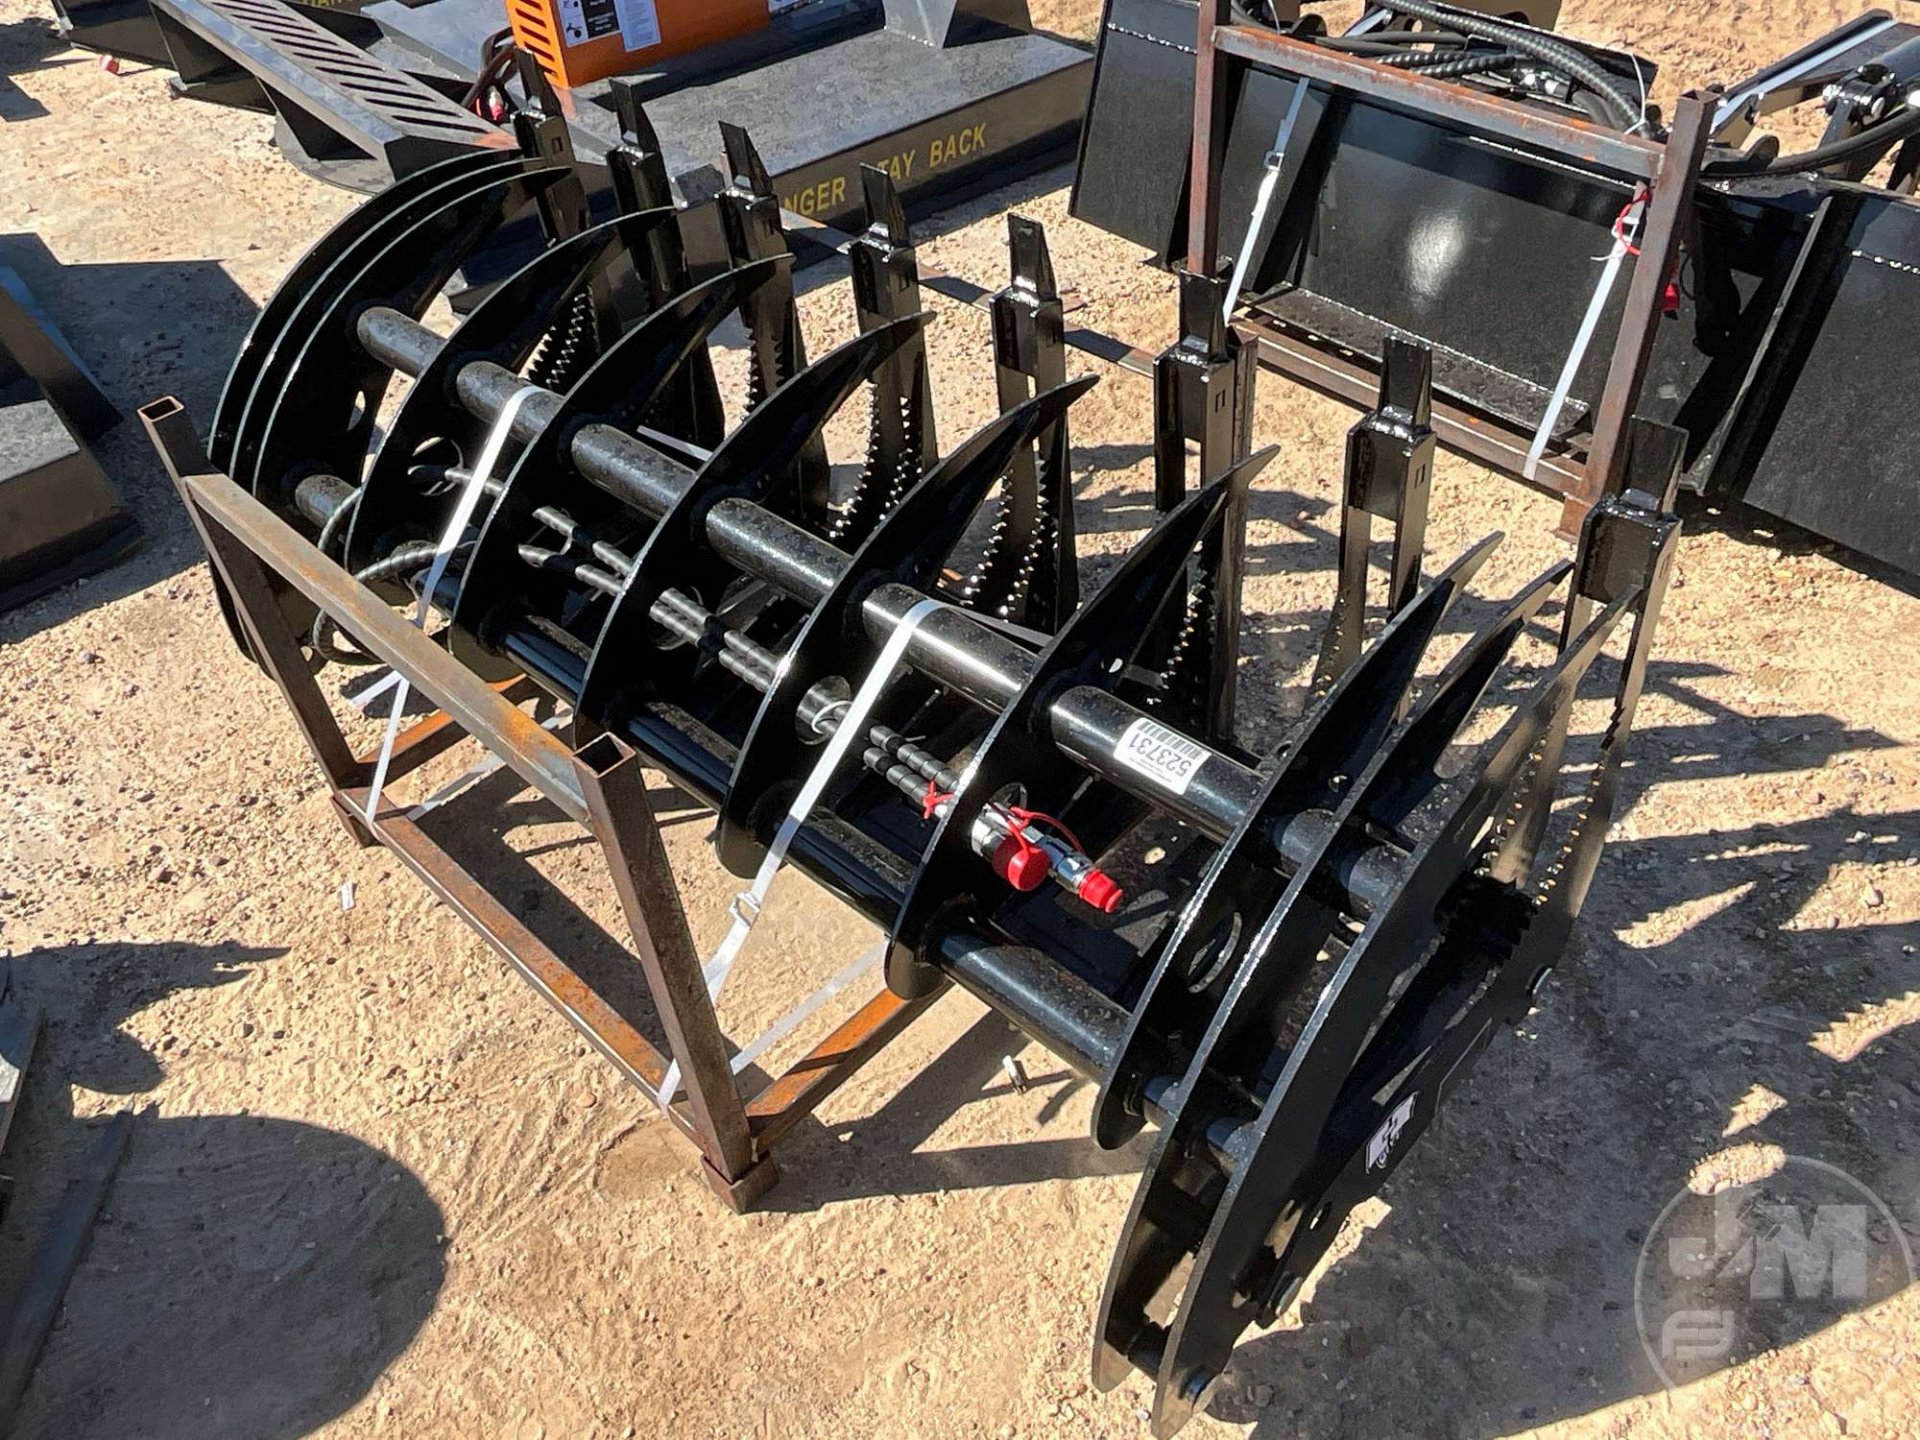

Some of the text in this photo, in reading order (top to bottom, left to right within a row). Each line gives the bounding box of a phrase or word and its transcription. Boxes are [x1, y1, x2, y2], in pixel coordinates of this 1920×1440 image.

[783, 122, 988, 216] NGER TAY BACK
[1128, 733, 1192, 777] 523731
